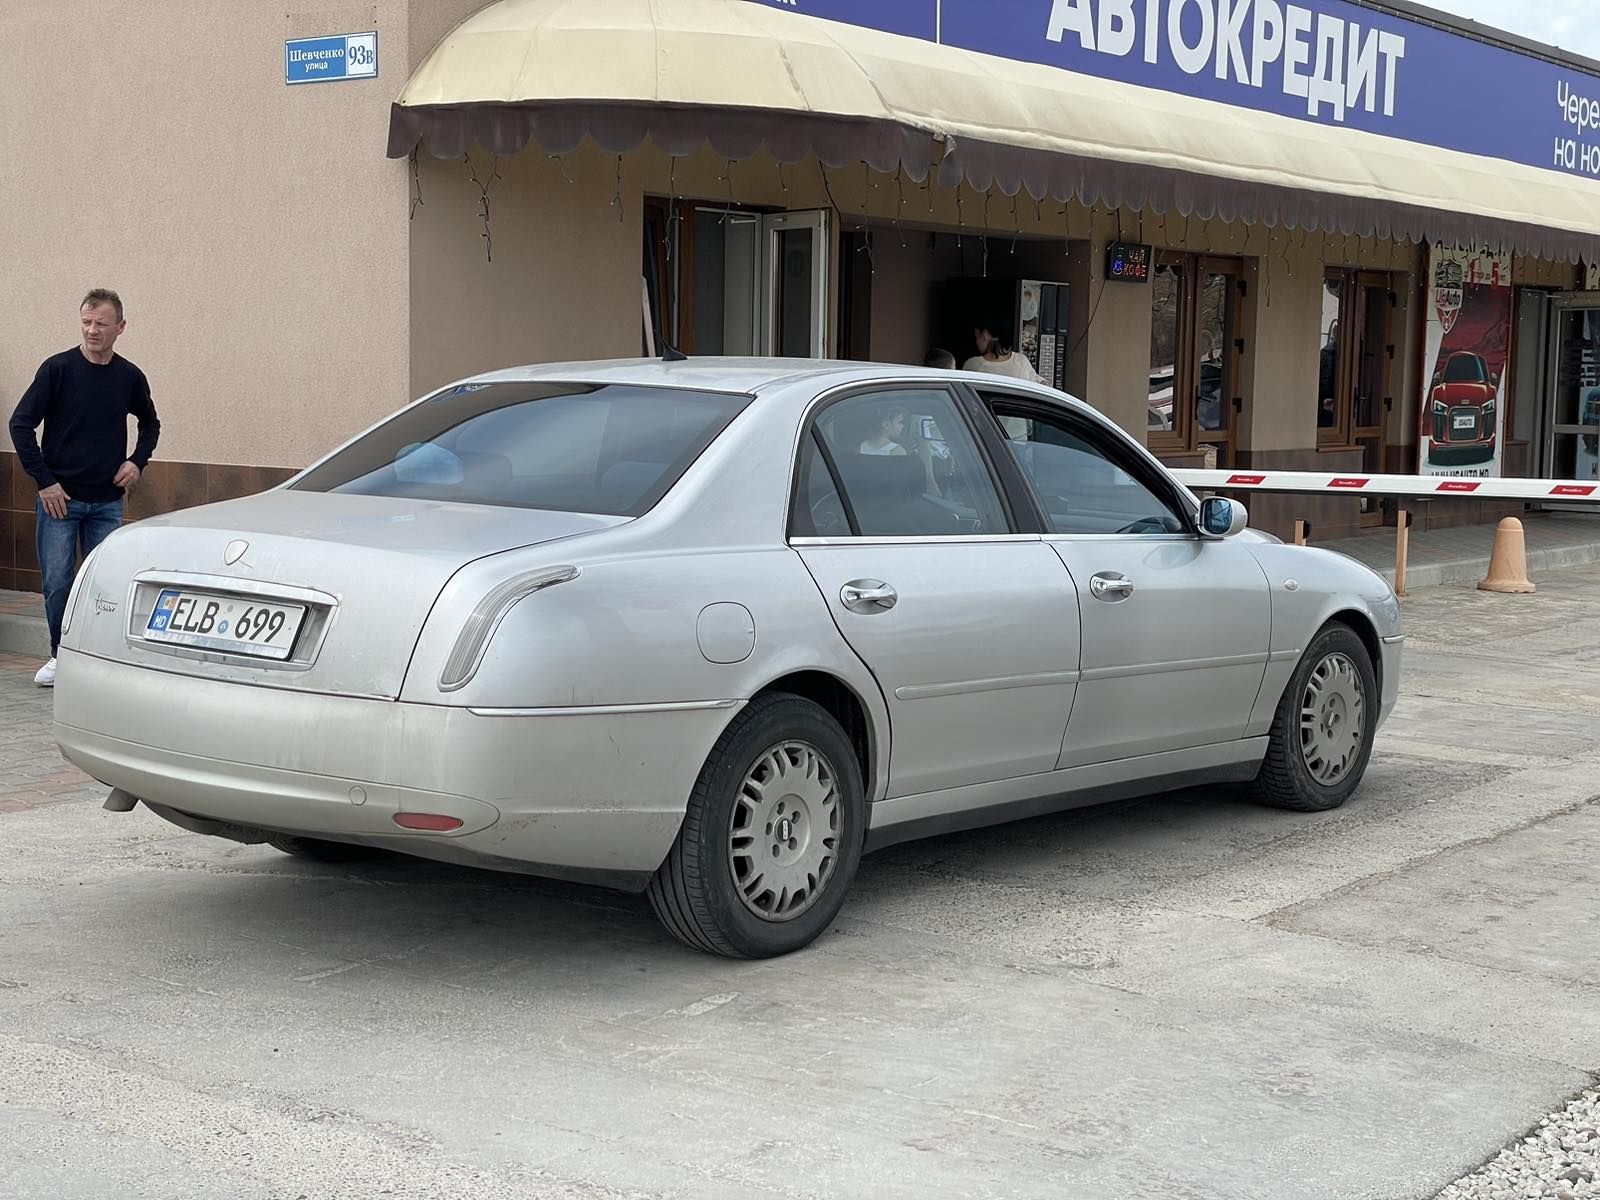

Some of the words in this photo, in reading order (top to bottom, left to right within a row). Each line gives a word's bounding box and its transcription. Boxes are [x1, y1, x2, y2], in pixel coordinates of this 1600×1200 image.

[290, 48, 344, 61] Шевченко
[305, 61, 328, 72] улица
[1046, 0, 1405, 122] АВТОКРЕДИТ
[1557, 80, 1600, 135] Чере
[1554, 137, 1576, 169] на
[153, 615, 167, 628] MD
[168, 598, 220, 634] ELB
[234, 607, 286, 643] 699
